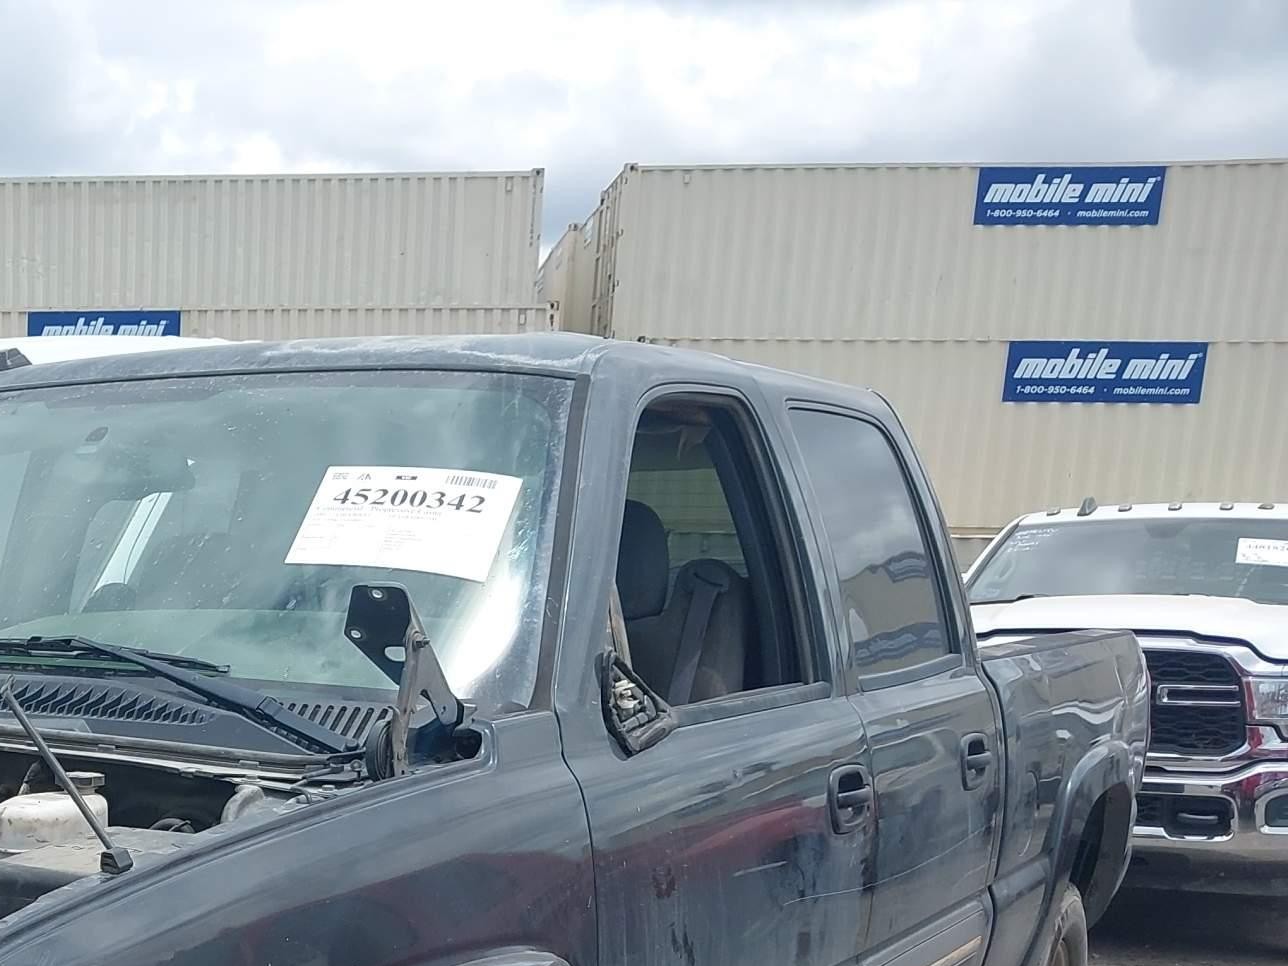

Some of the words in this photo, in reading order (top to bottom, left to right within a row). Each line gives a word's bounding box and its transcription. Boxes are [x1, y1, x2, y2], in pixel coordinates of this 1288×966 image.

[984, 174, 1084, 203] mobile
[1084, 177, 1157, 203] mini
[987, 209, 1060, 218] 1-800-950-6464
[1076, 209, 1149, 217] mobilemini.com
[1013, 348, 1122, 379] mobile
[1122, 353, 1198, 380] mini
[1016, 385, 1095, 394] 1-800-950-6464
[1113, 386, 1190, 395] mobilemini.com
[332, 488, 486, 514] 45200342
